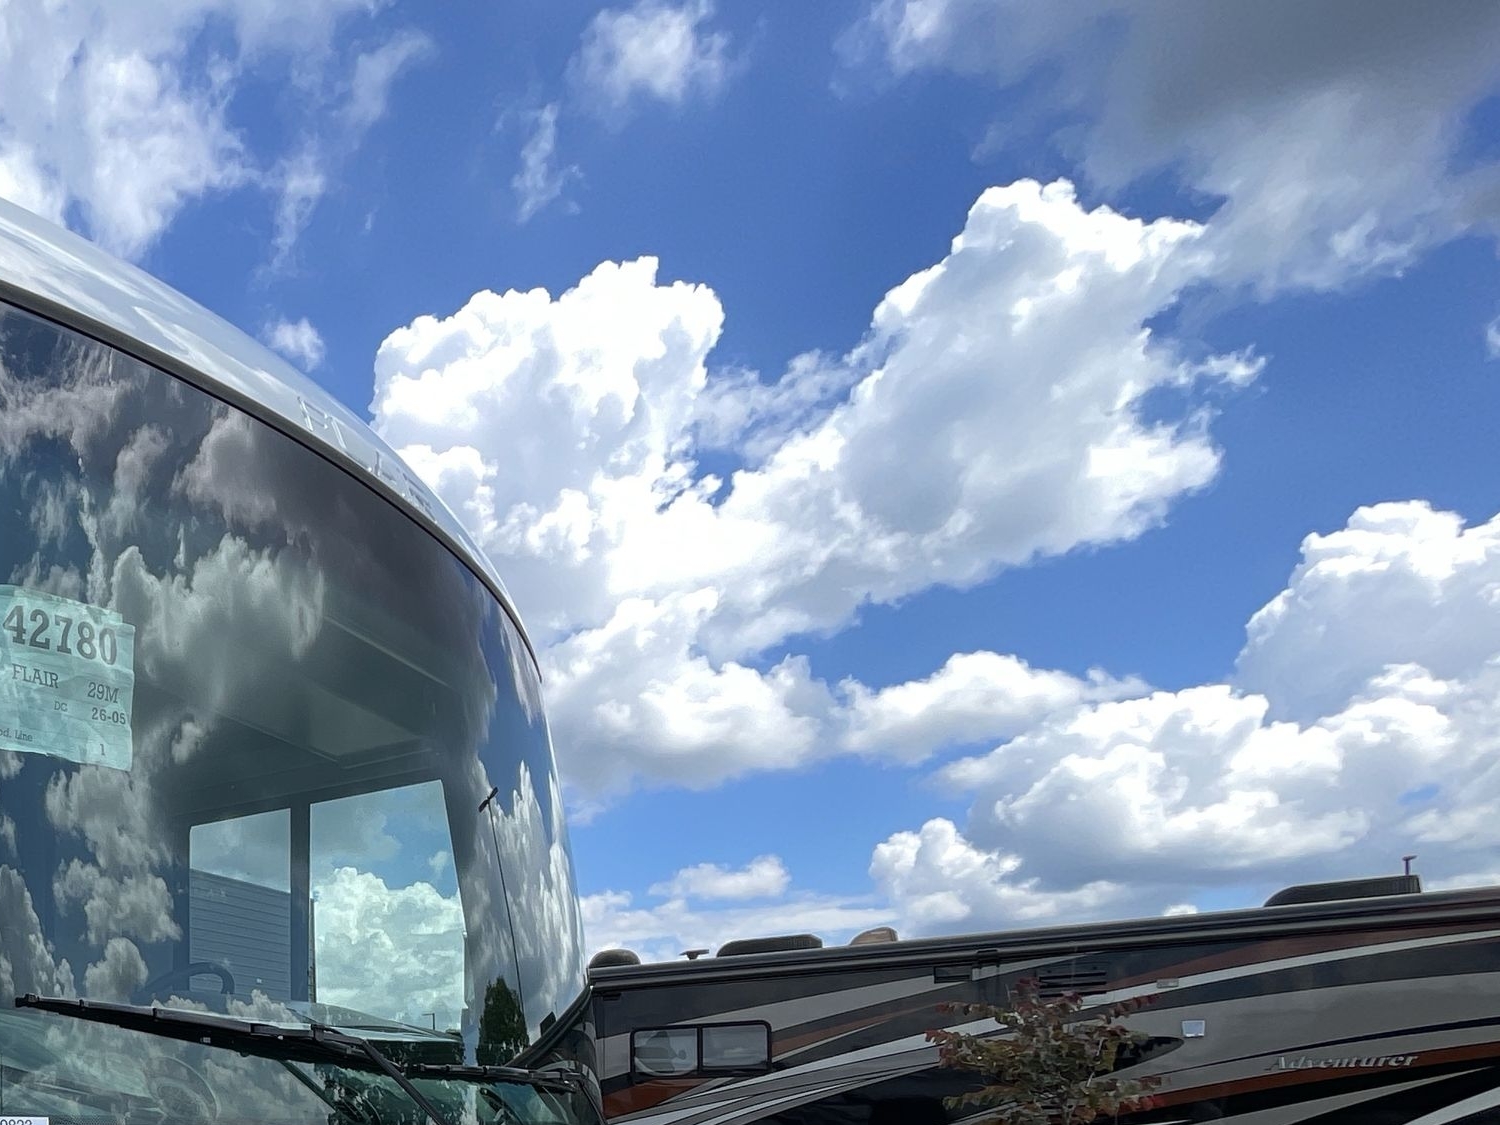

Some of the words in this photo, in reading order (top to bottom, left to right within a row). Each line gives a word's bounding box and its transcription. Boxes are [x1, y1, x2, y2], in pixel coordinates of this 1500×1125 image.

[2, 605, 118, 666] 42780
[11, 663, 59, 689] FLAIR
[87, 681, 120, 704] 29M
[91, 706, 126, 725] 26-05
[1265, 1055, 1419, 1071] Adventurer
